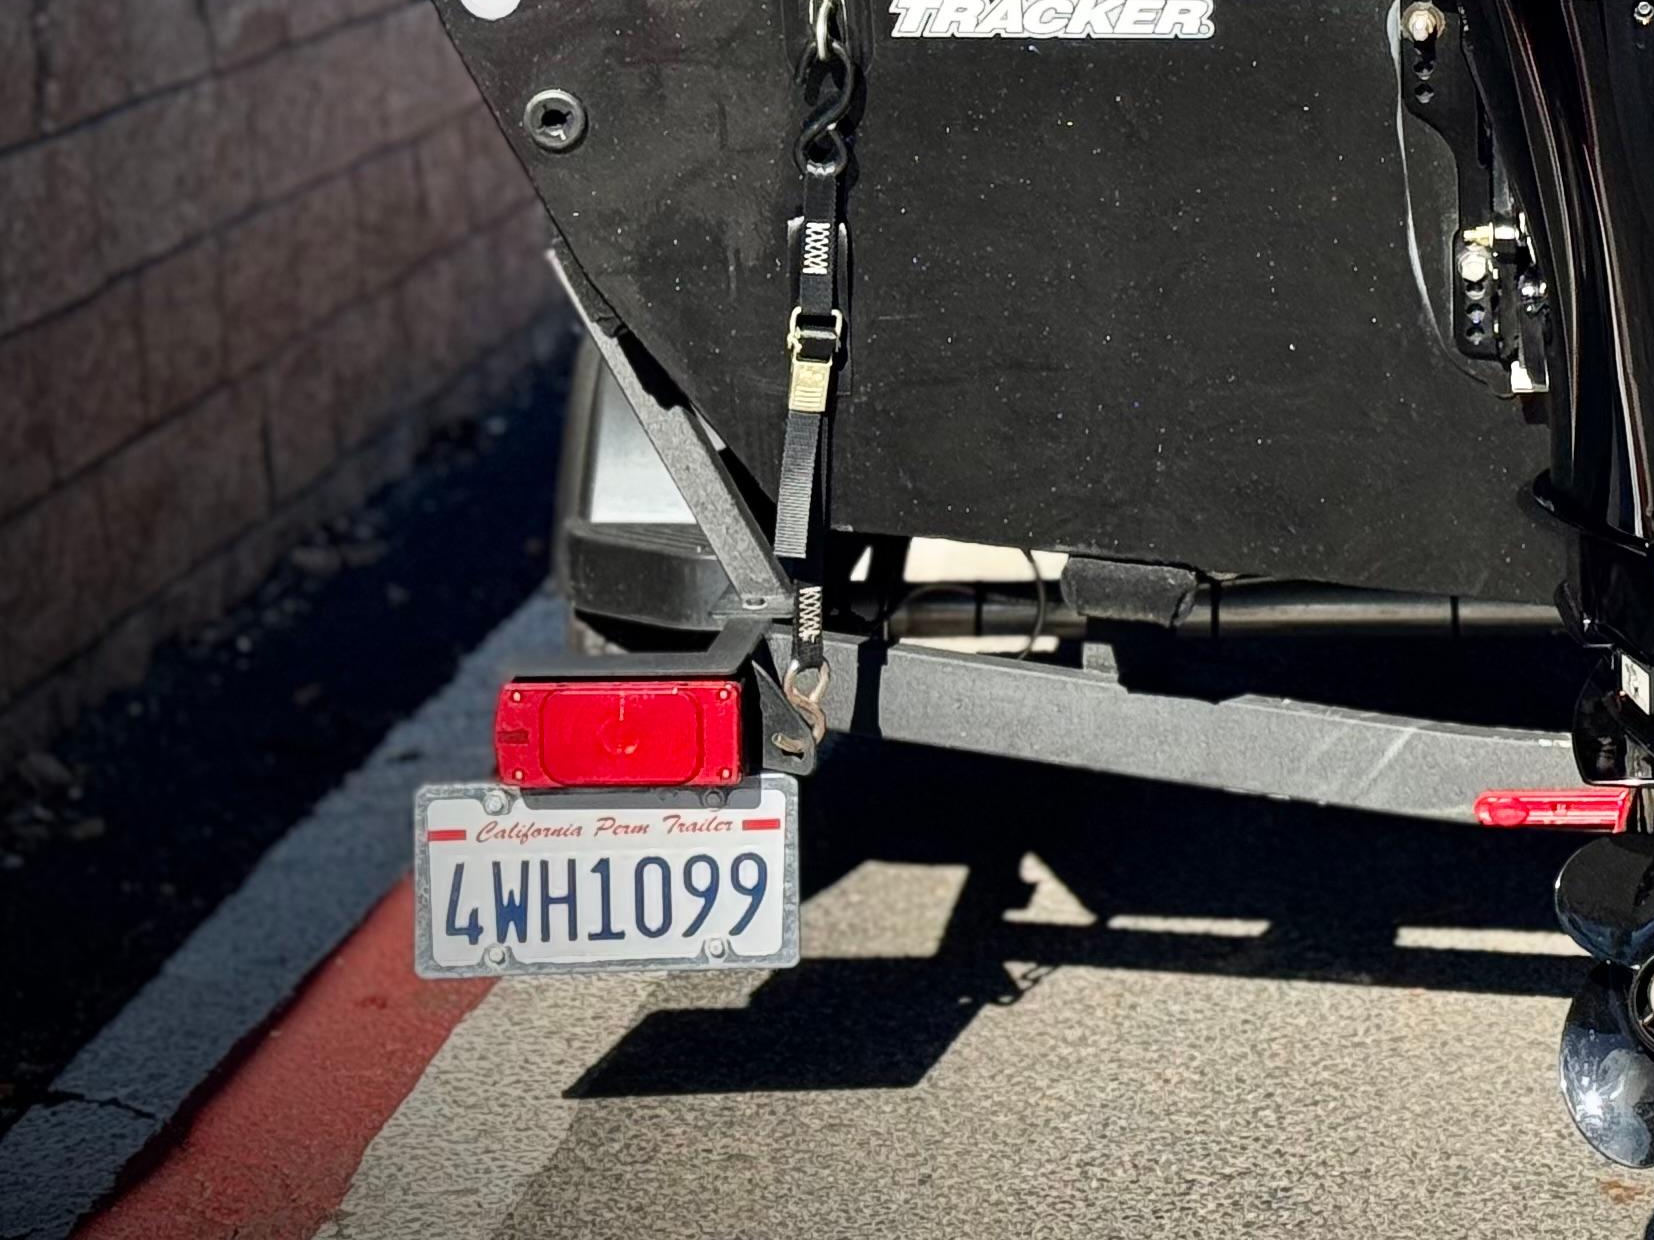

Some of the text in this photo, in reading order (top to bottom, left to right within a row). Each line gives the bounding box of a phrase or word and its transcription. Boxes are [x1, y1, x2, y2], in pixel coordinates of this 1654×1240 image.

[476, 814, 735, 845] California Perm Trailer
[445, 852, 768, 946] 4WH1099
